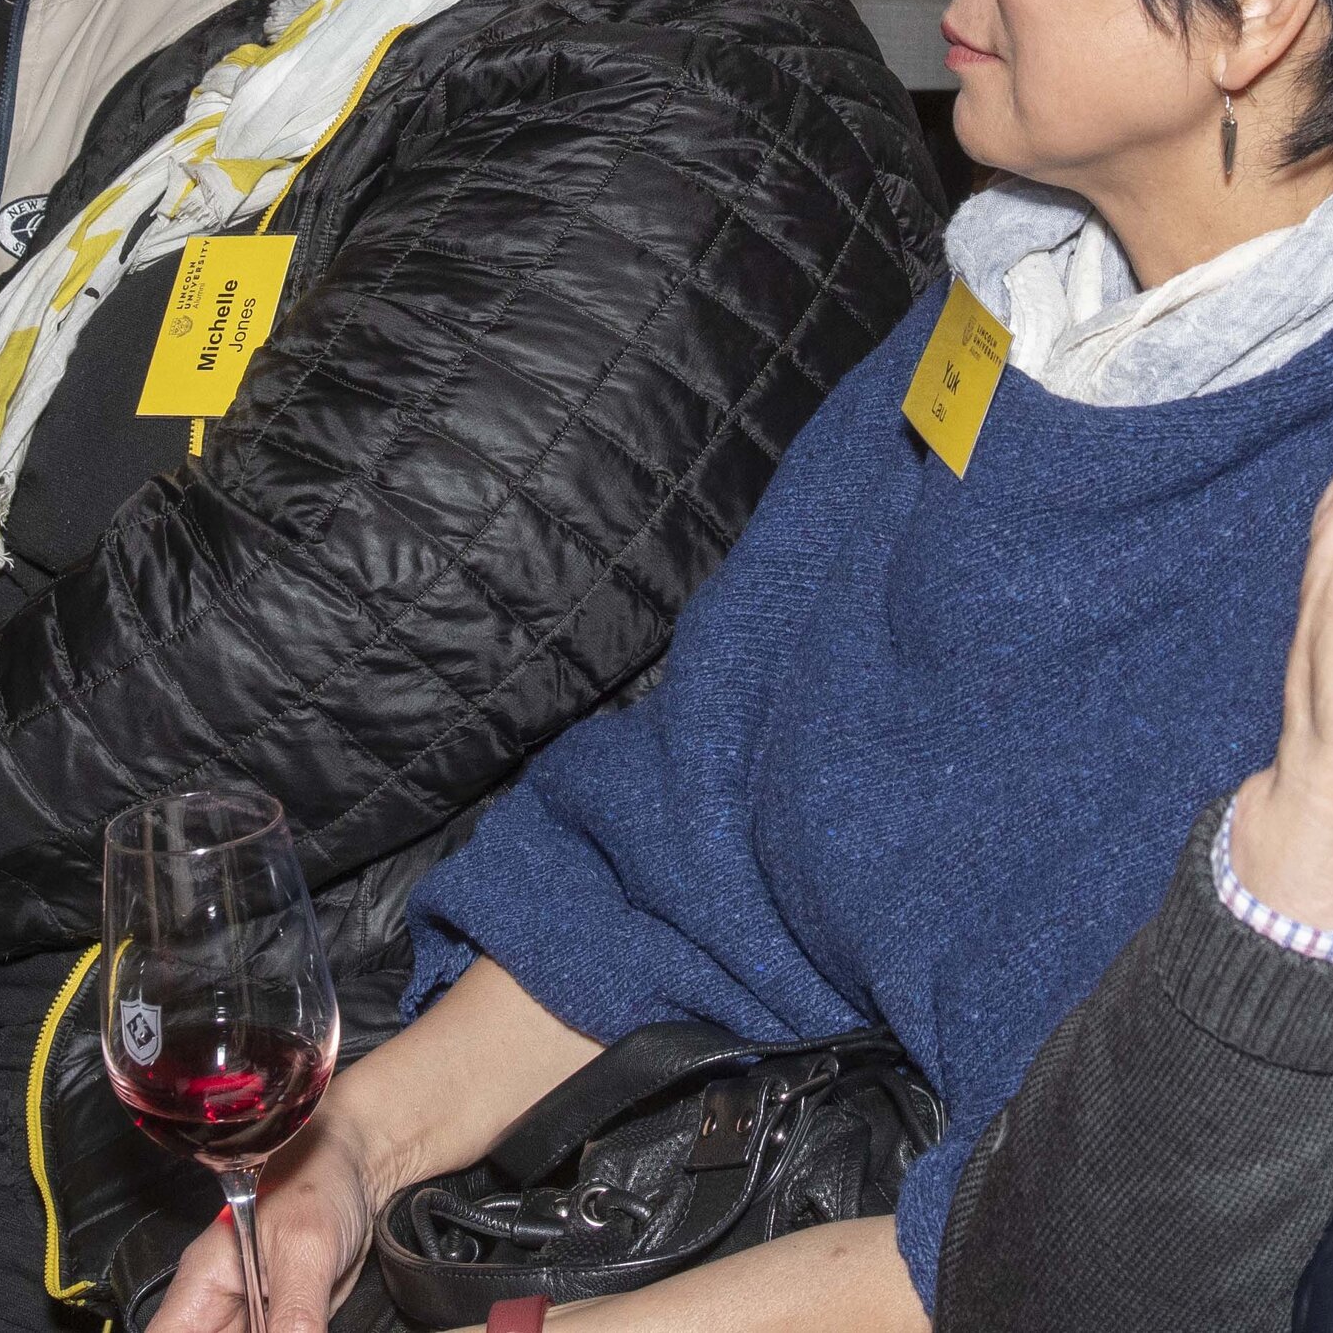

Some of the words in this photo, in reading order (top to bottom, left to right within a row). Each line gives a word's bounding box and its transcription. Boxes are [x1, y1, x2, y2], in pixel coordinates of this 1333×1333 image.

[7, 200, 37, 218] NEW
[176, 261, 196, 309] LINCOLN
[184, 240, 210, 309] UNIVERSITY
[197, 279, 238, 371] Michelle
[229, 298, 256, 352] Jones
[942, 360, 961, 395] Yuk
[931, 393, 947, 423] Lau
